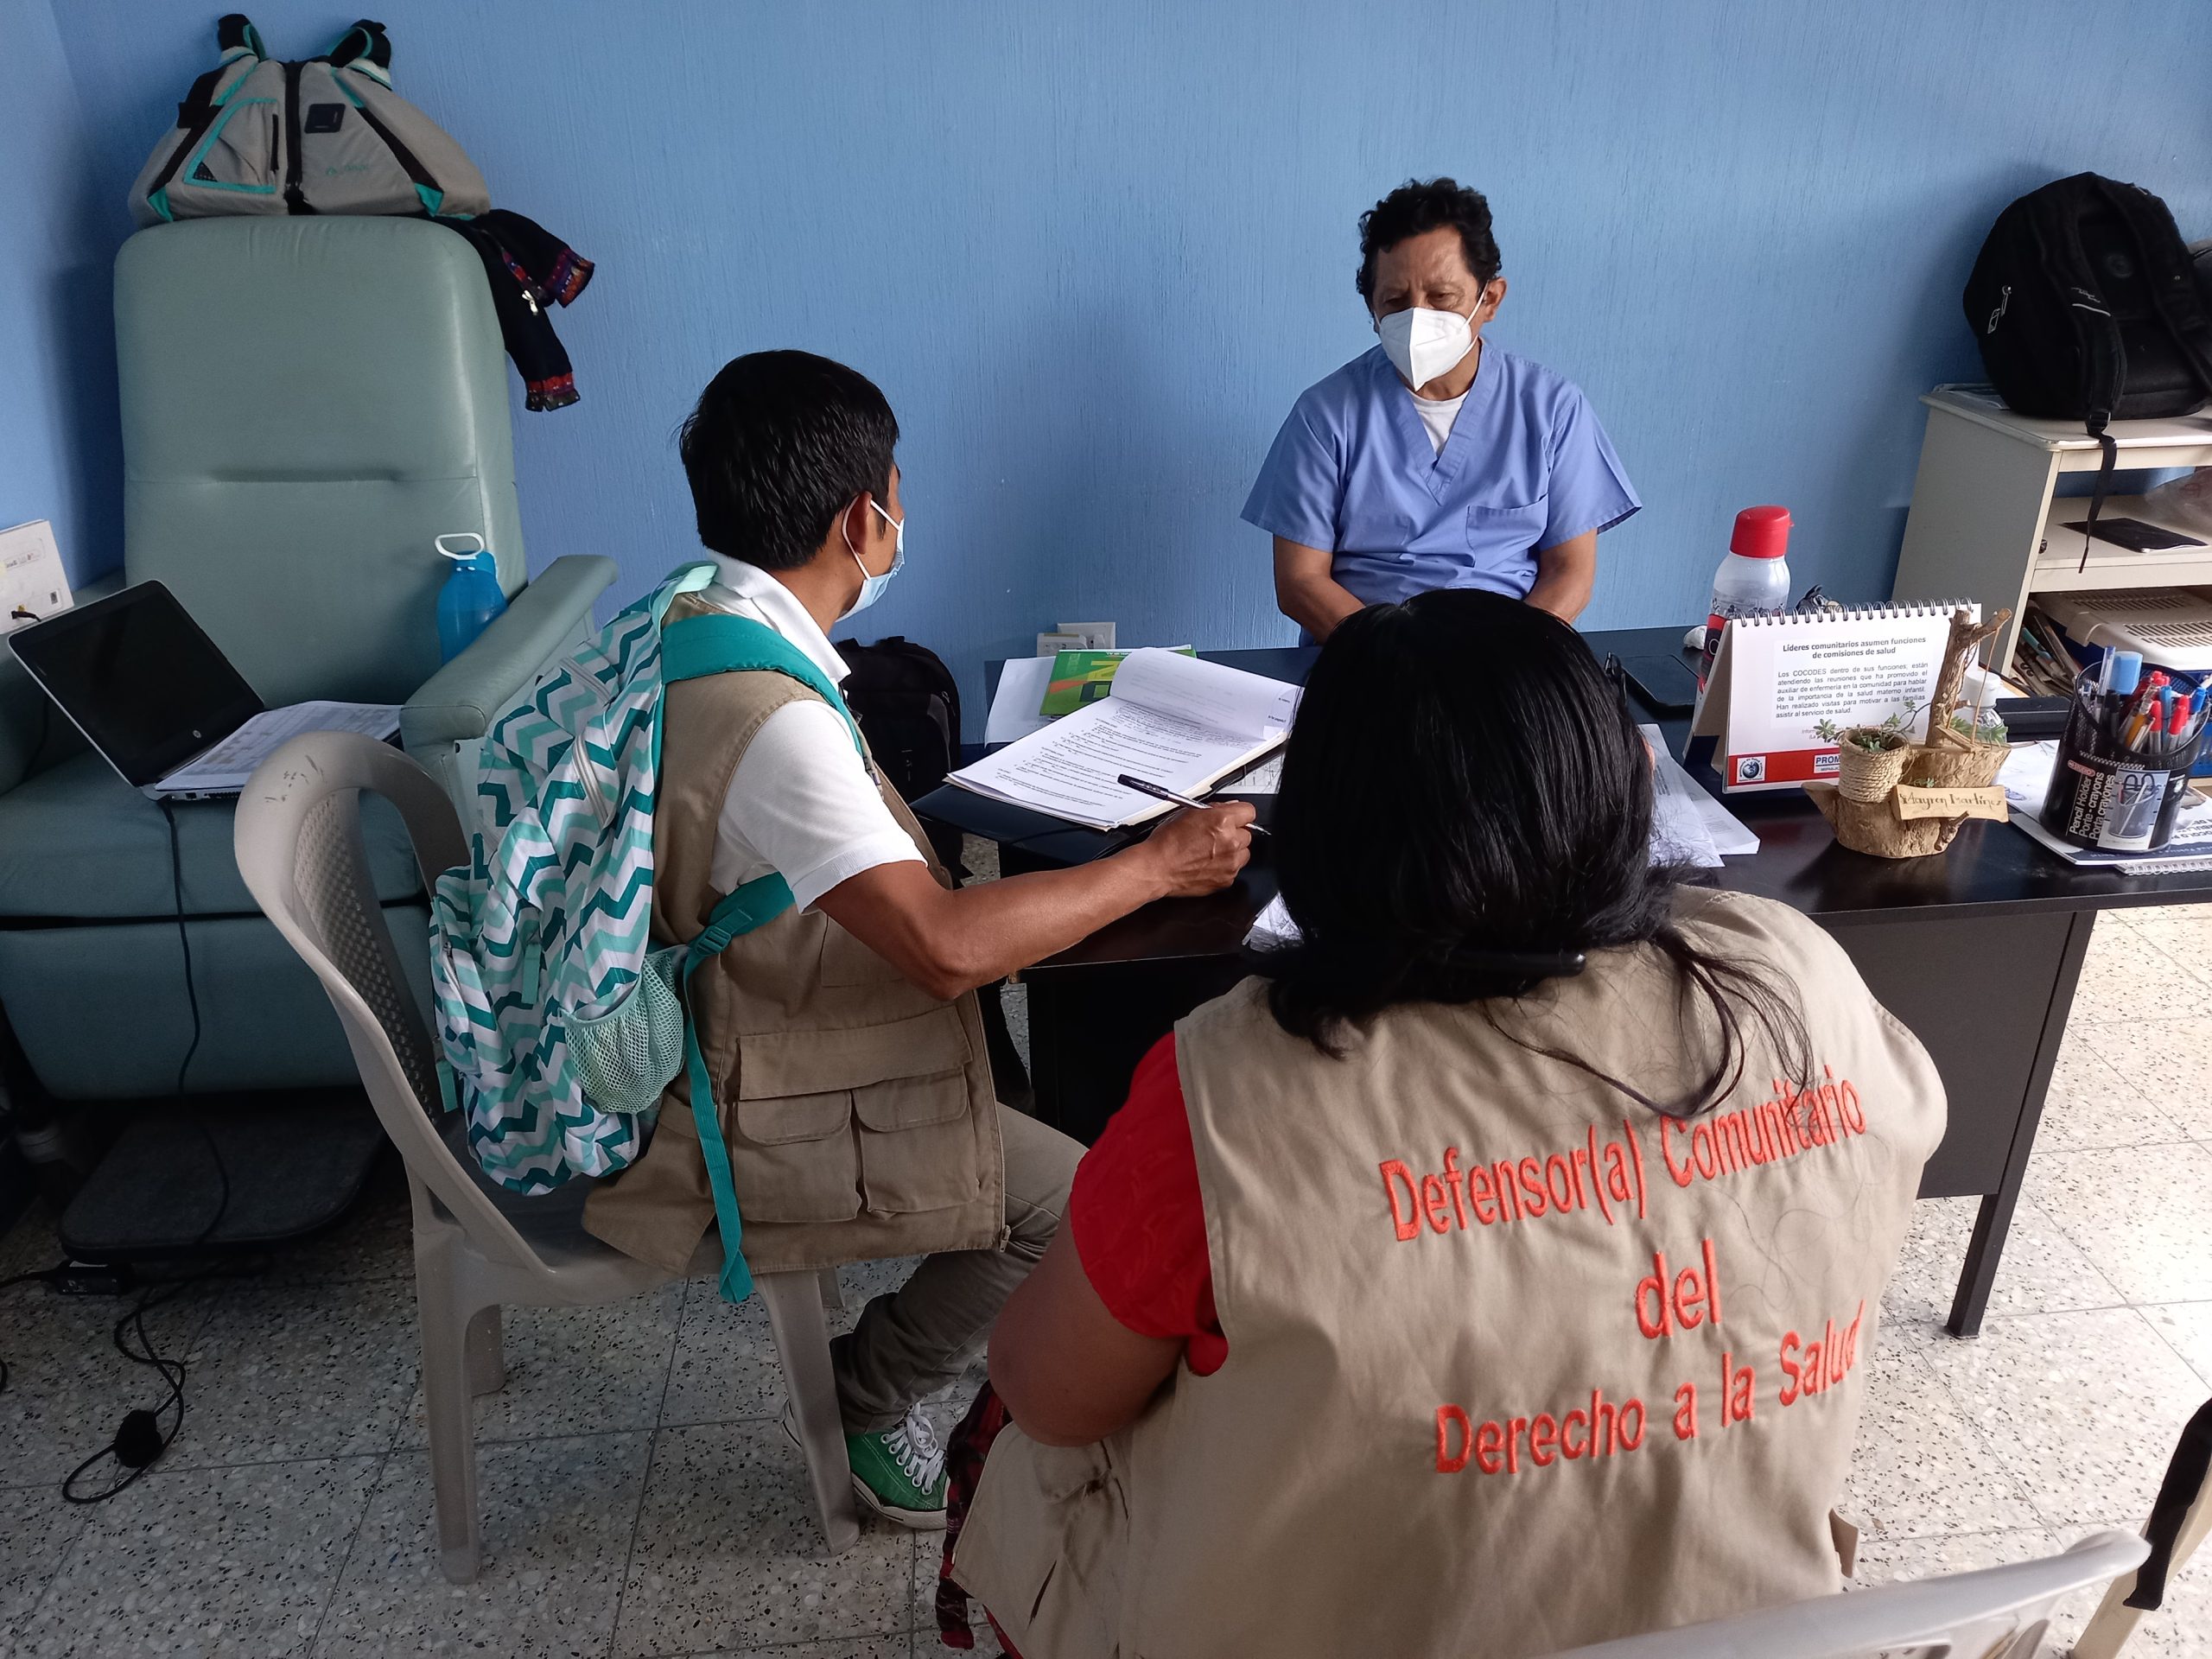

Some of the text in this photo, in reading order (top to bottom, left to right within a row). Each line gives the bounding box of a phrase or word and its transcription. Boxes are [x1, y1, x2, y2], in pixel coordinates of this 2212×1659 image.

[1811, 641, 1859, 650] comunitarios
[1823, 650, 1864, 658] comisiones
[1877, 646, 1896, 655] salud
[1777, 677, 1811, 686] atendiendo
[1887, 671, 1918, 679] promovido
[1797, 693, 1832, 702] importancia
[1777, 710, 1794, 719] asistir
[1815, 755, 1839, 764] PROM
[2075, 776, 2092, 807] Holder
[2078, 813, 2094, 838] Porte
[2088, 772, 2105, 809] crayons
[2069, 805, 2084, 835] Pencil
[2088, 774, 2115, 840] Porta crayones
[1379, 1065, 1866, 1242] Defensor(a) Comunitario
[1636, 1238, 1721, 1339] del
[1435, 1300, 1866, 1474] Derecho a la Salud
